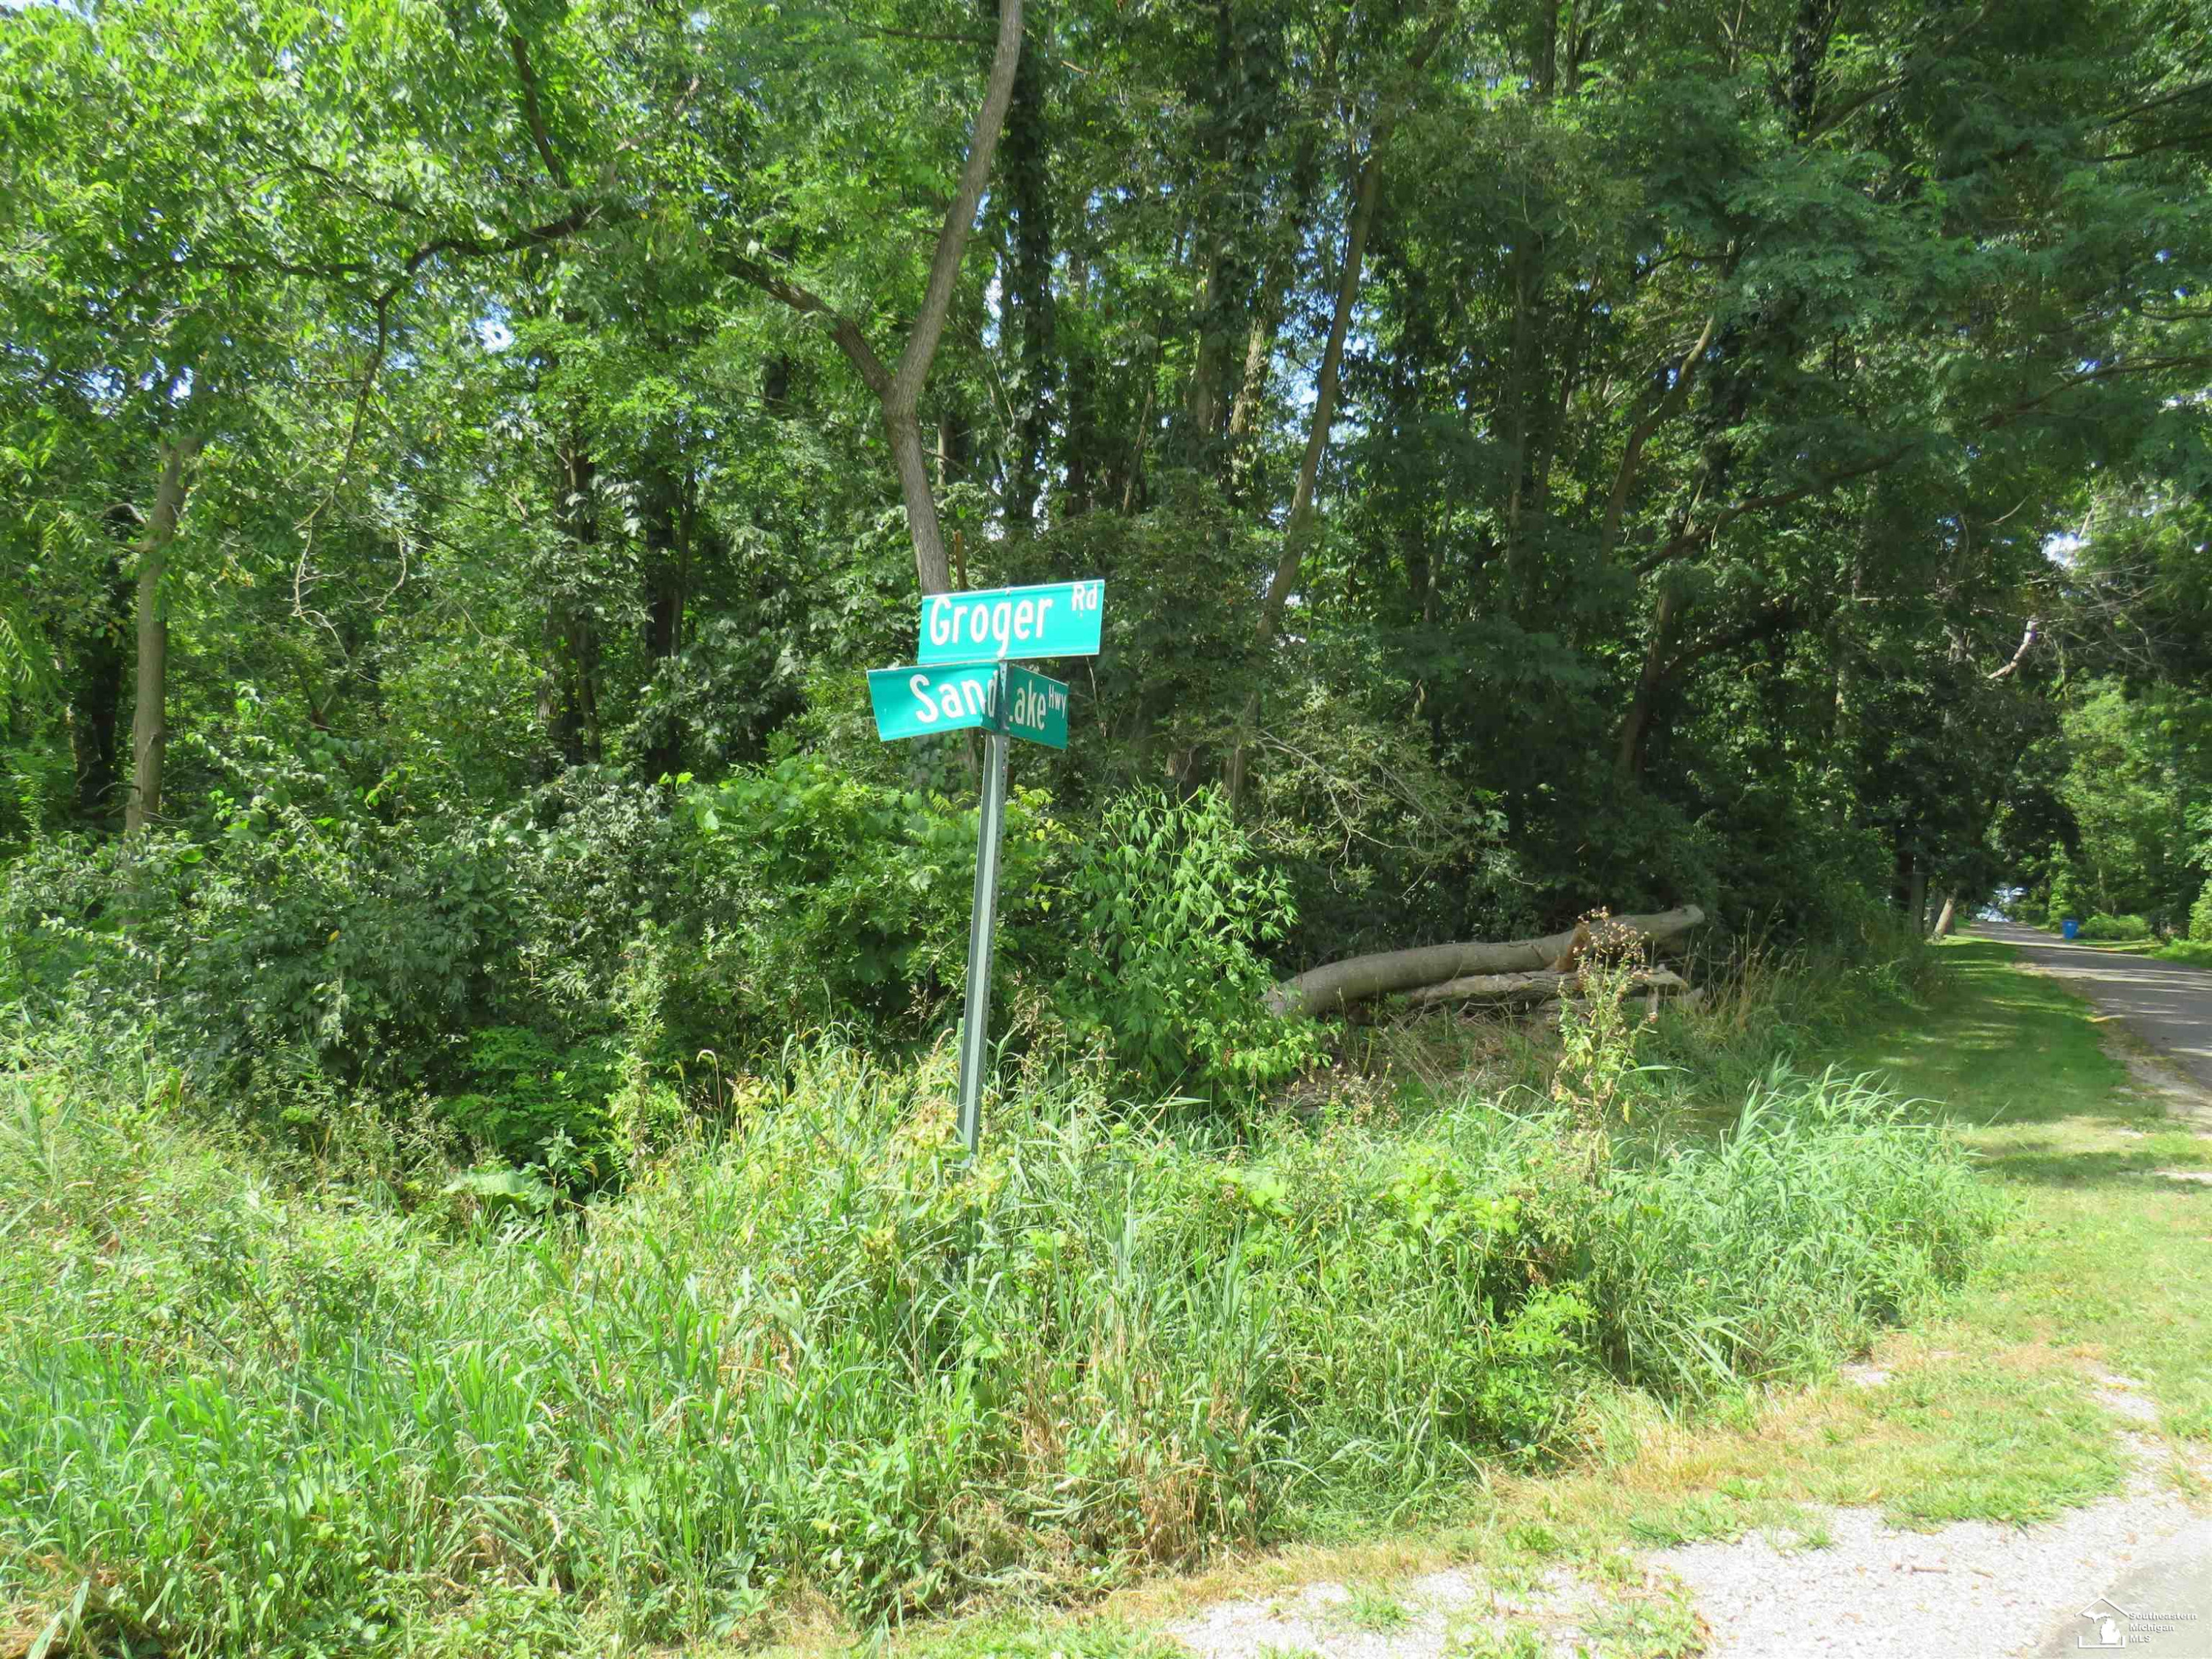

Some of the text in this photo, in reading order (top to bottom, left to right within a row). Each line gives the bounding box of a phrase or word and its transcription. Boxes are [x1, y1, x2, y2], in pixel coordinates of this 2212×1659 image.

[929, 583, 1098, 658] Groger Rd
[909, 669, 1066, 731] Sand ake Hwy
